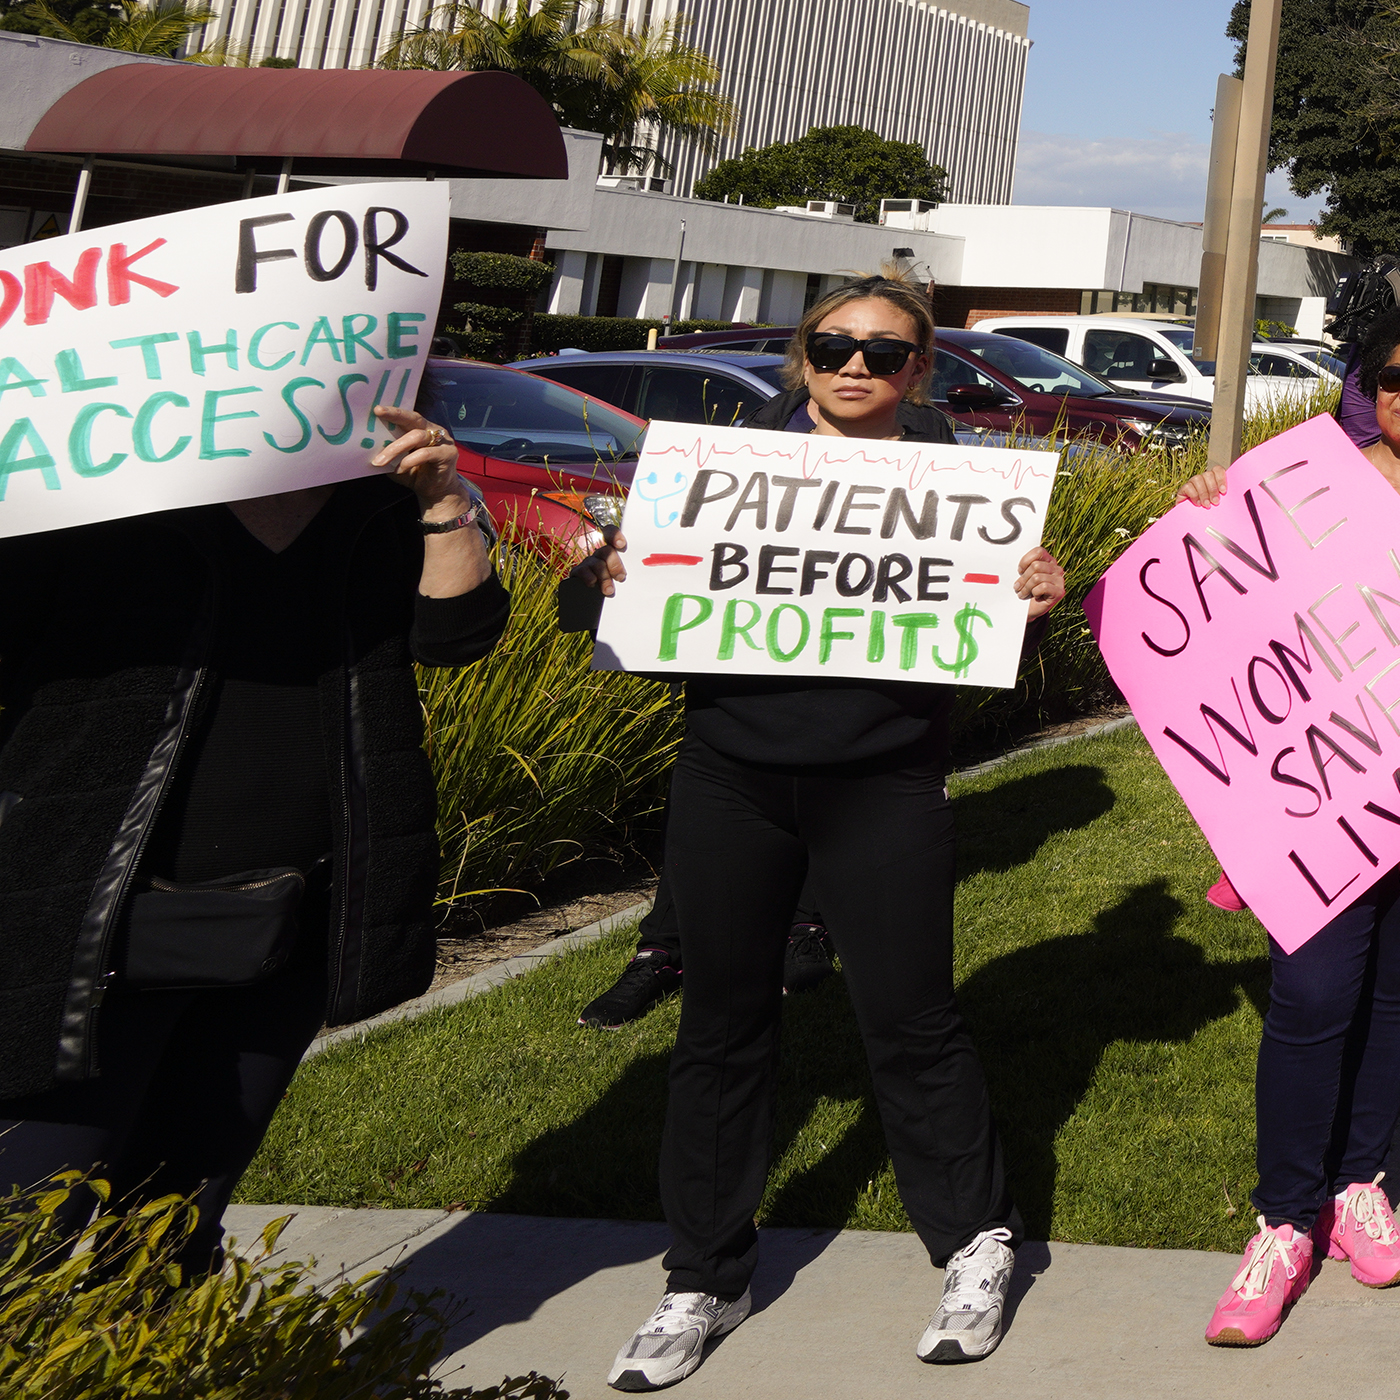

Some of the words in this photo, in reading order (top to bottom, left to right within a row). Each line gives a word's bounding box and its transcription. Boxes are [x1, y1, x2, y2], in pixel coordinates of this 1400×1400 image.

[235, 206, 429, 294] FOR
[680, 469, 1036, 545] PATIENTS
[708, 542, 954, 603] BEFORE
[1138, 459, 1348, 658] SAVE
[657, 592, 994, 679] PROFIT$
